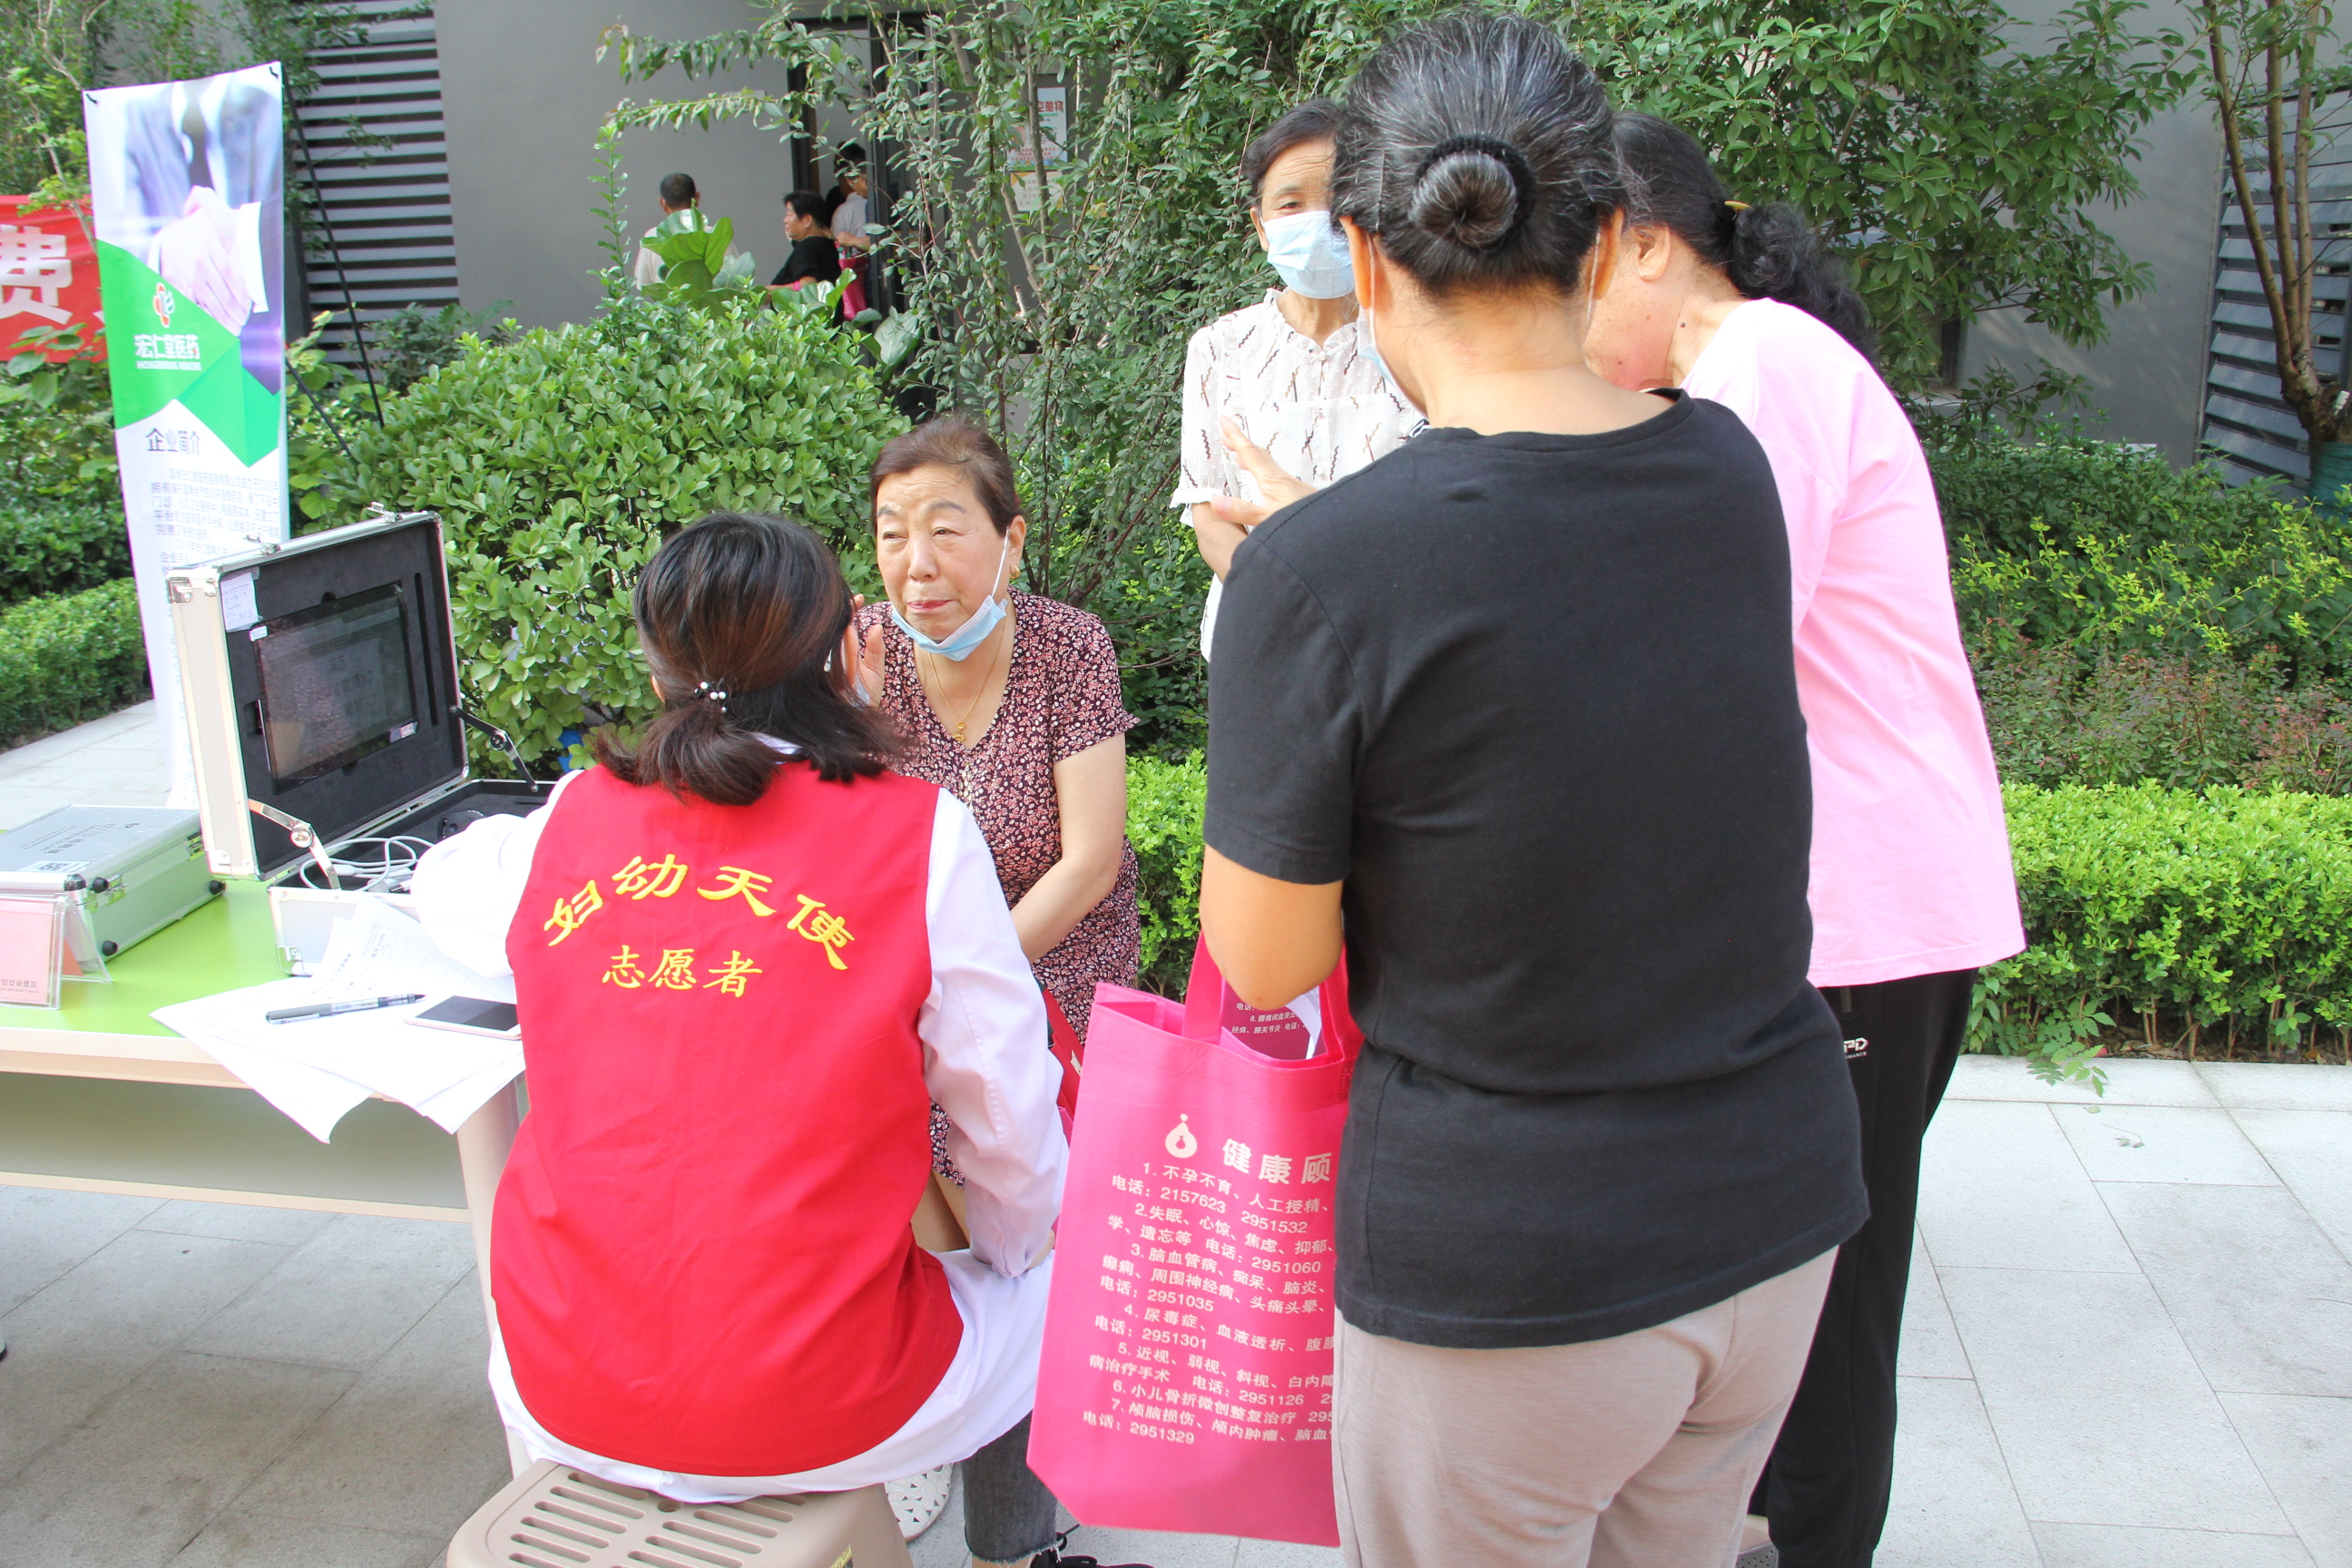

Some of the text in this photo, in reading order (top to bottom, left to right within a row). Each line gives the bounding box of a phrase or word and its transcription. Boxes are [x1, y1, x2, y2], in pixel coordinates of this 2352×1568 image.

[0, 224, 74, 325] 费
[145, 428, 201, 455] 企业简介
[544, 854, 855, 970] 妇幼天使
[0, 978, 37, 988] 妇幼保健院
[603, 945, 762, 997] 志愿者
[1222, 1138, 1332, 1184] 健康顾
[1108, 1214, 1191, 1246] 学、遗忘等
[1240, 1210, 1308, 1233] 2951532
[1089, 1354, 1170, 1383] 病治疗手术
